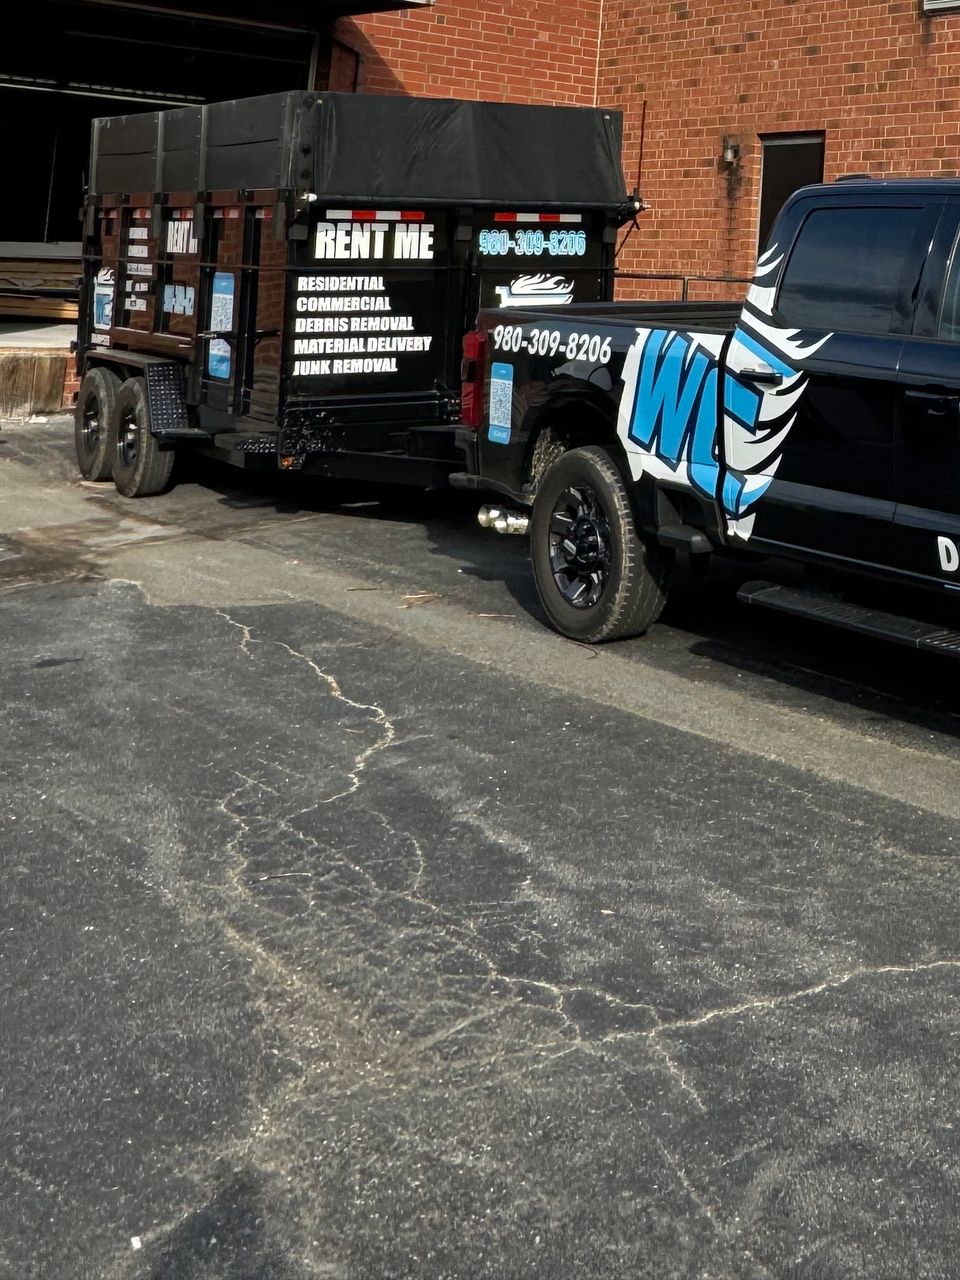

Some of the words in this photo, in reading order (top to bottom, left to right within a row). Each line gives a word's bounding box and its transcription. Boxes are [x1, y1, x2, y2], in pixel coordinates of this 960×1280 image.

[314, 222, 389, 259] RENT
[393, 222, 435, 260] ME
[297, 276, 386, 292] RESIDENTIAL
[296, 296, 392, 312] COMMERCIAL
[295, 317, 350, 333] DEBRIS
[350, 316, 415, 332] REMOVAL
[293, 337, 366, 355] MATERIAL
[366, 336, 433, 352] DELIVERY
[493, 324, 612, 365] 980-309-8206
[292, 359, 331, 376] JUNK
[332, 357, 399, 374] REMOVAL
